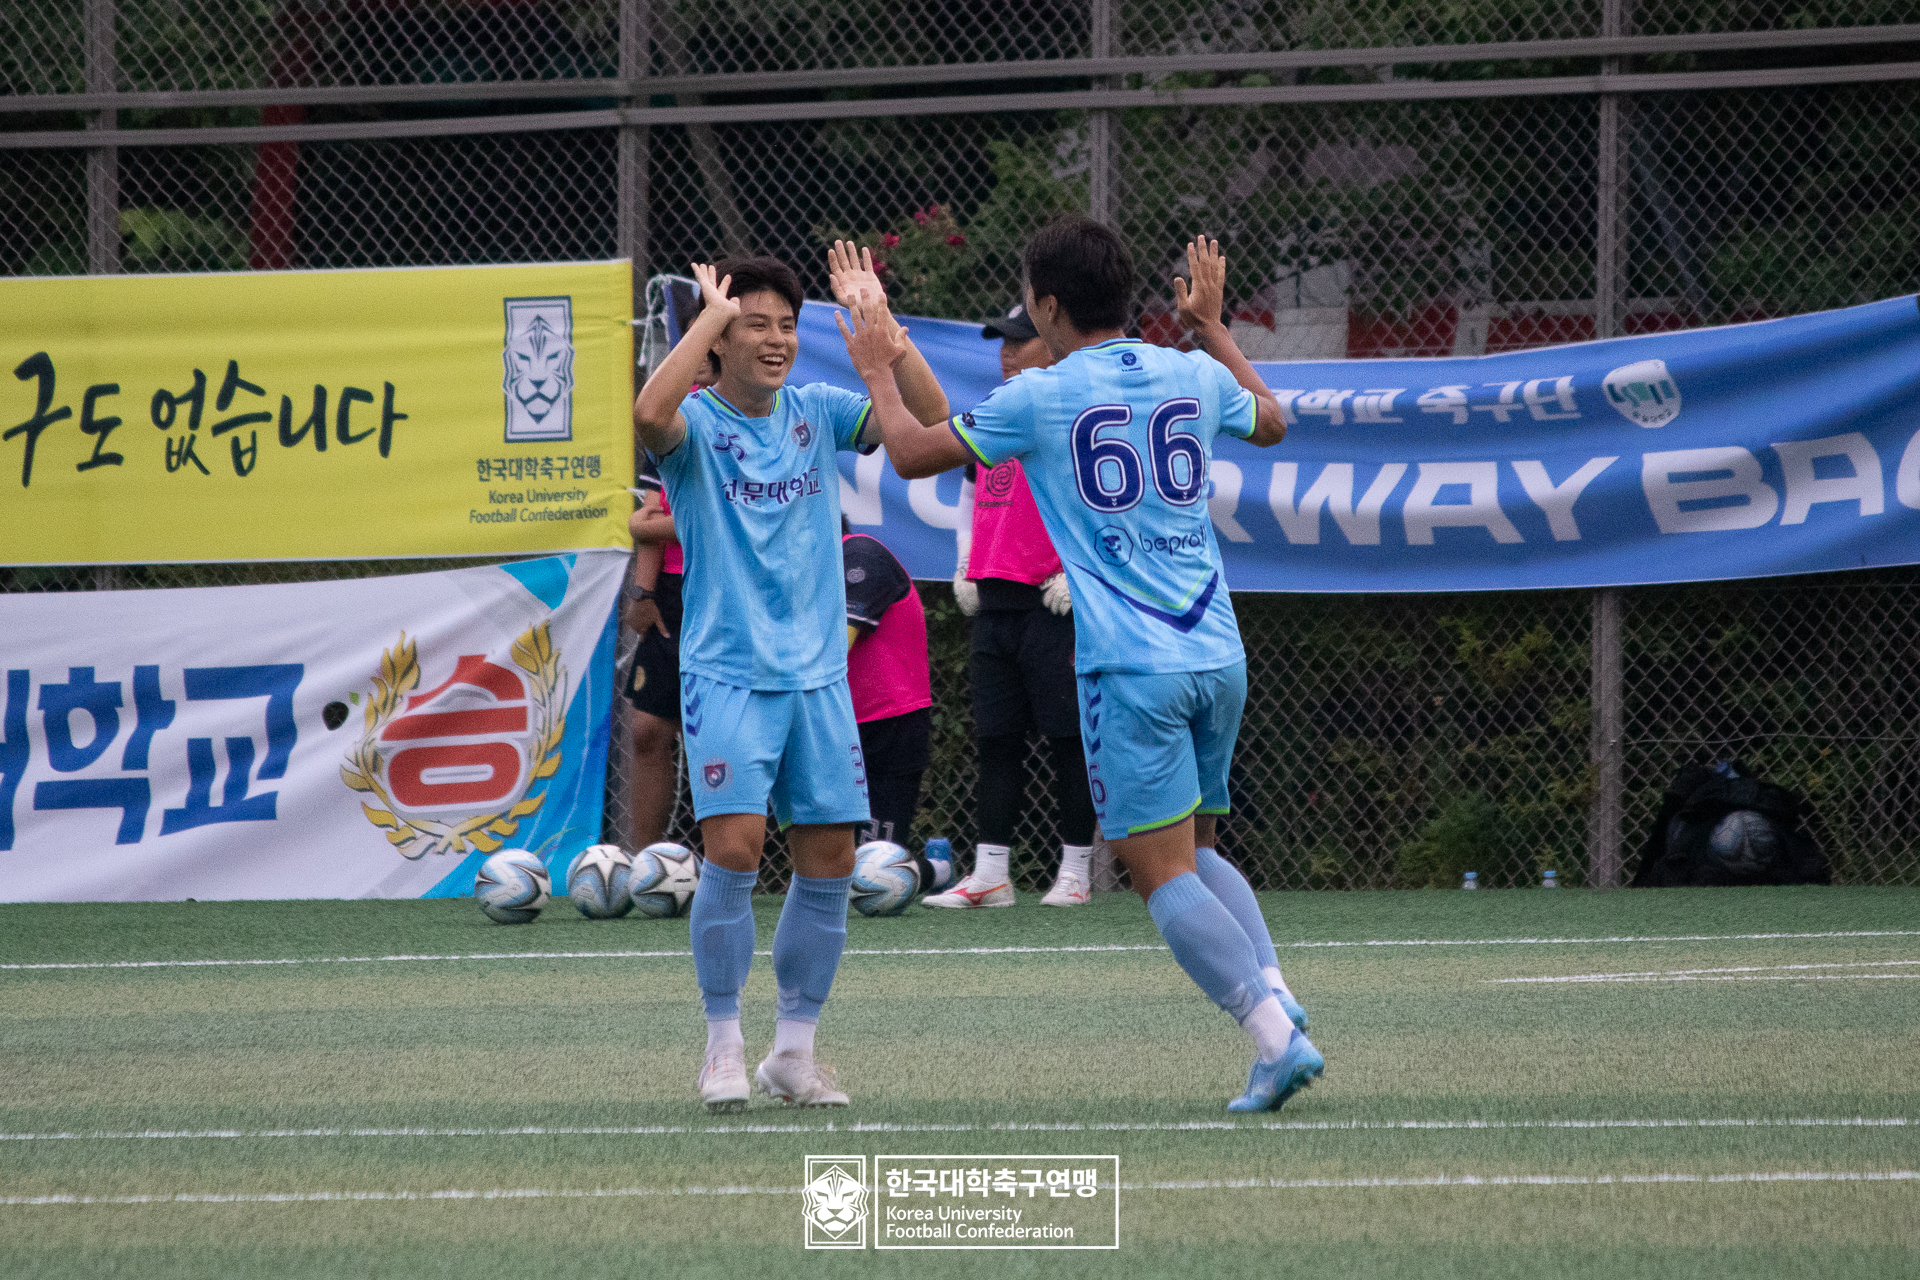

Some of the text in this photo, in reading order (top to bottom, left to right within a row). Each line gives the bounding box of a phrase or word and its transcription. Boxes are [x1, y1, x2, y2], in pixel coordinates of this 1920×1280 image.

[2, 351, 408, 488] 구도 없습니다
[476, 454, 602, 482] 한국대학축구연맹
[1070, 397, 1206, 513] 66
[1642, 429, 1920, 535] BA
[469, 505, 608, 523] Football Confederation
[488, 486, 588, 504] Korea University
